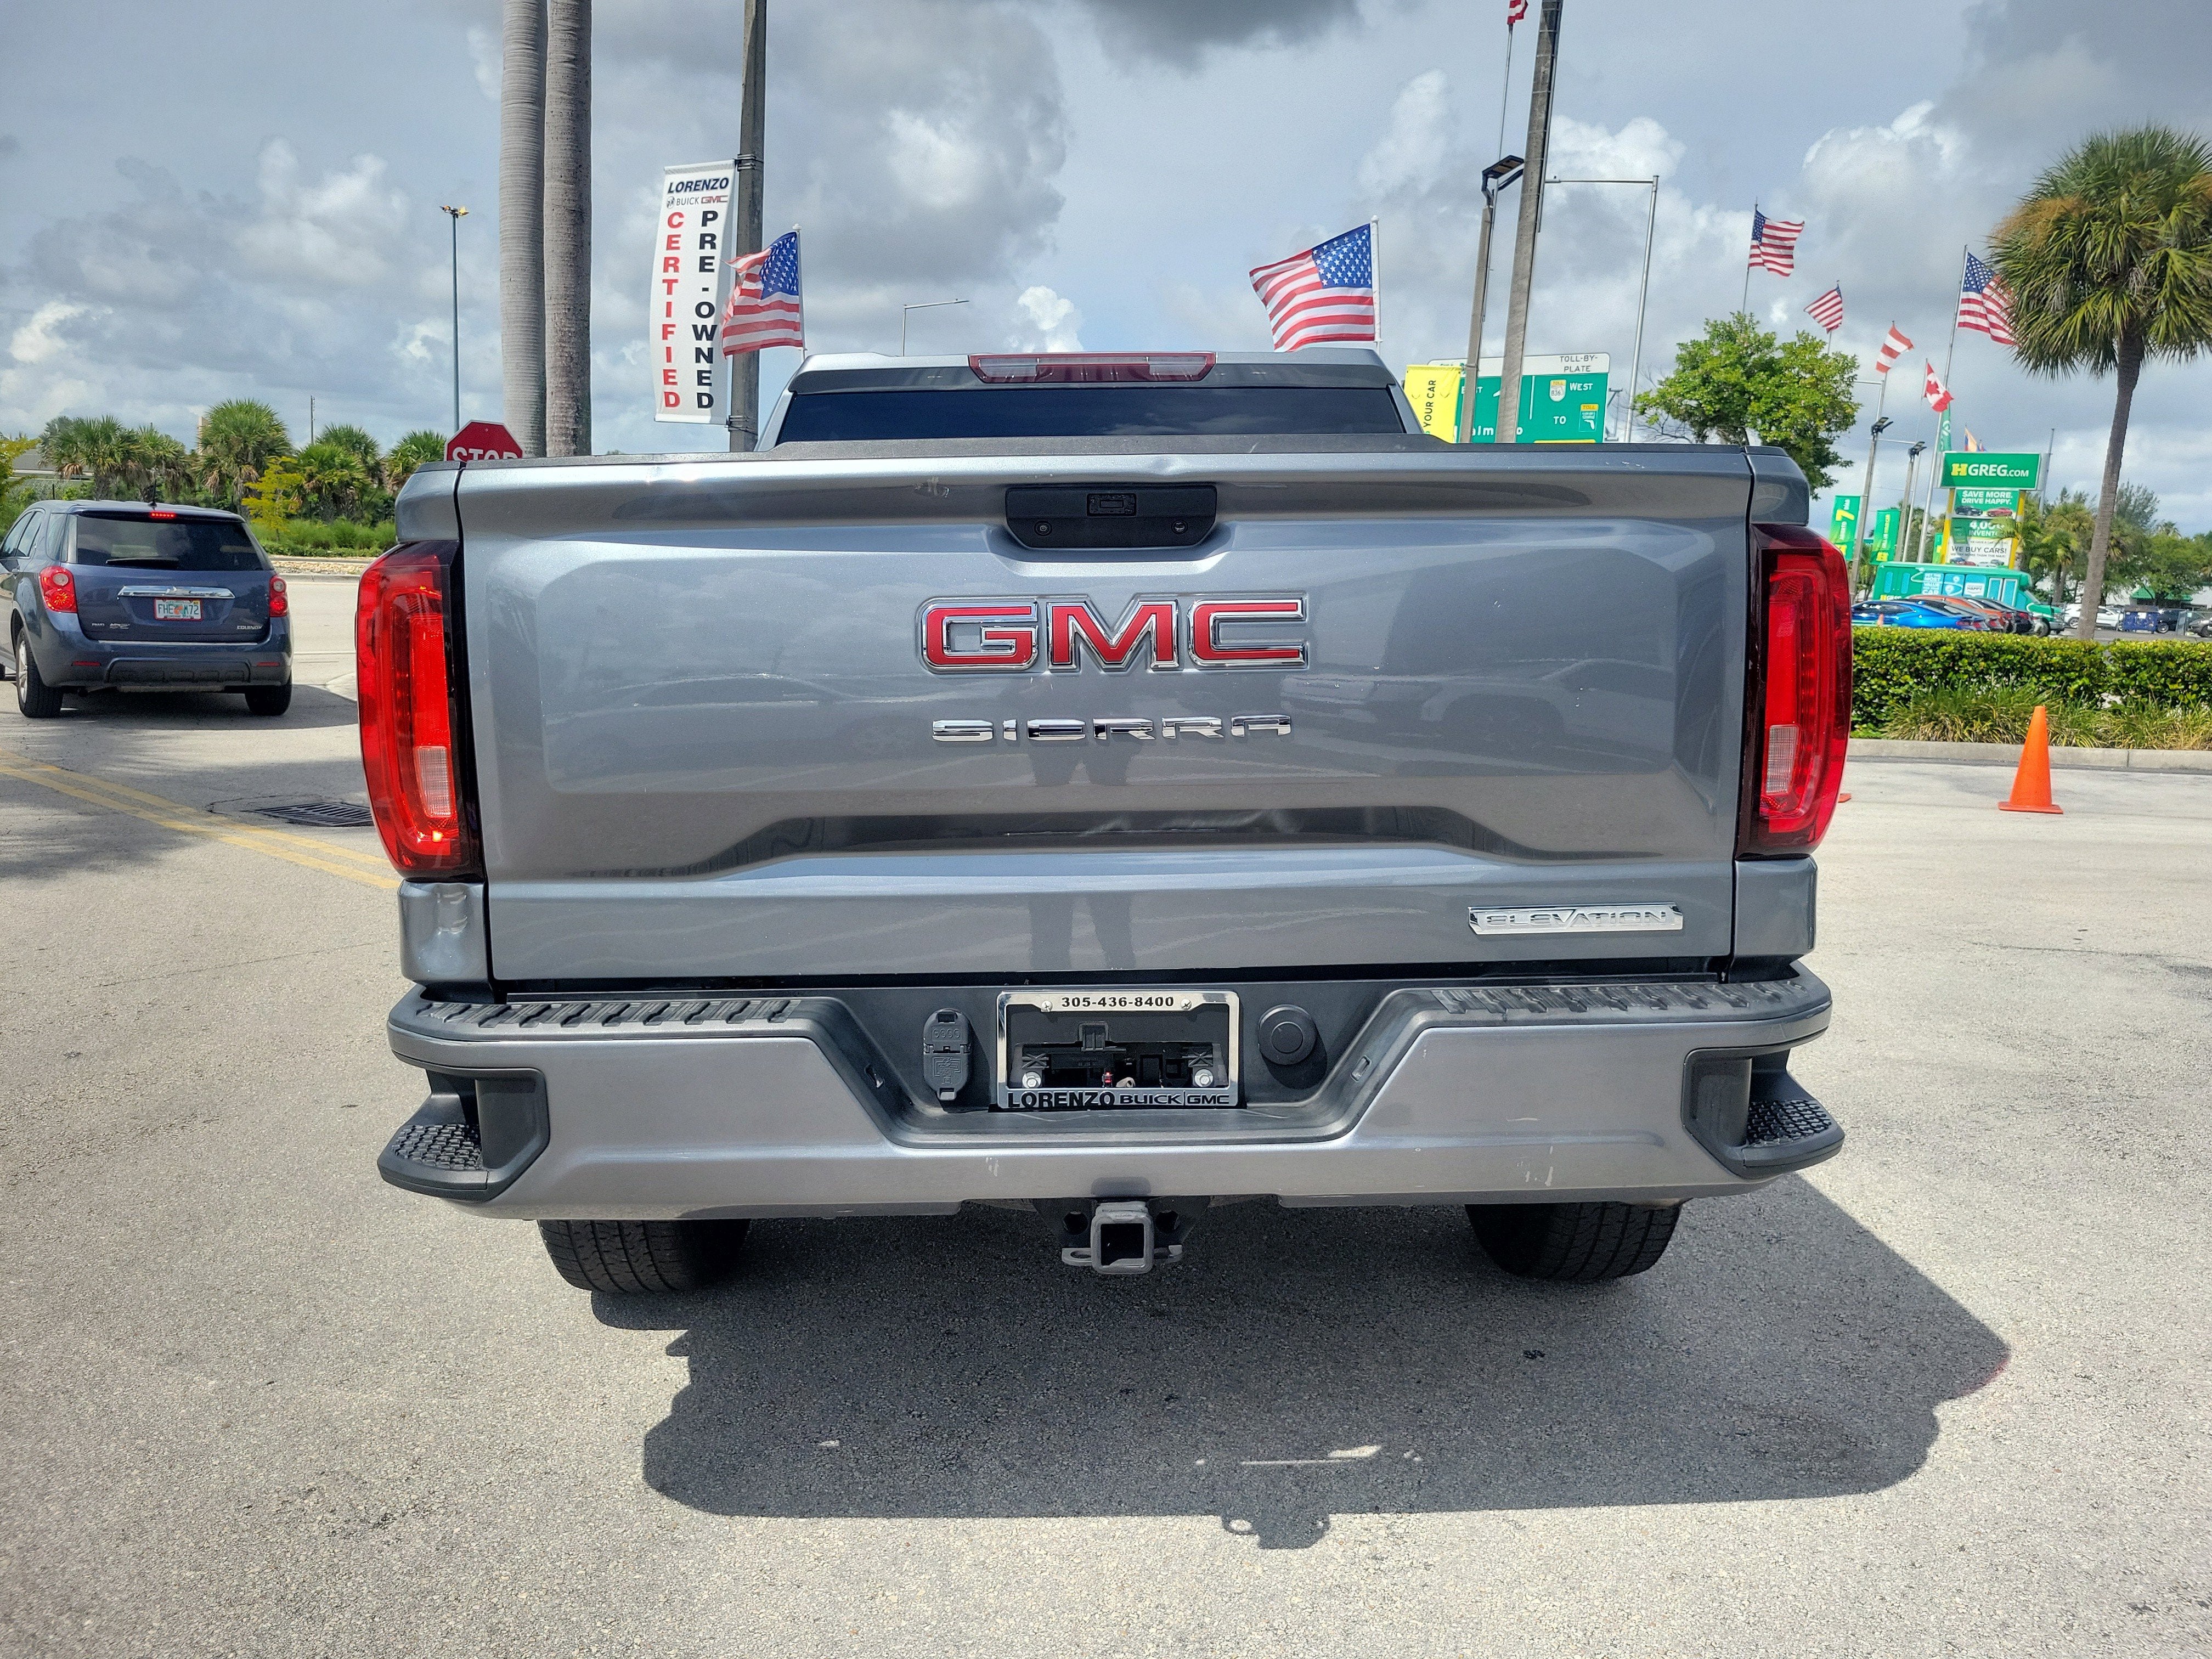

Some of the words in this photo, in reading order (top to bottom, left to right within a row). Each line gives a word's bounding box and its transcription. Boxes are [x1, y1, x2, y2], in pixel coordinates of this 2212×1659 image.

[668, 177, 729, 193] LORENZO
[676, 197, 699, 206] BUICK
[701, 195, 728, 204] GMC
[662, 211, 684, 408] CERTIFIED
[692, 210, 718, 409] PRE-OWNED
[1427, 380, 1436, 398] CAR
[1570, 382, 1593, 391] WEST
[1424, 402, 1434, 427] YOUR
[1553, 415, 1566, 424] TO
[1835, 509, 1855, 521] 7
[923, 598, 1309, 670] GMC
[932, 715, 1291, 741] SIERRA
[1487, 911, 1666, 927] ELEVATION
[1062, 996, 1174, 1007] 305-436-8400
[1007, 1091, 1115, 1108] LORENZO
[1120, 1093, 1182, 1104] BUICK
[1187, 1093, 1229, 1104] GMC
